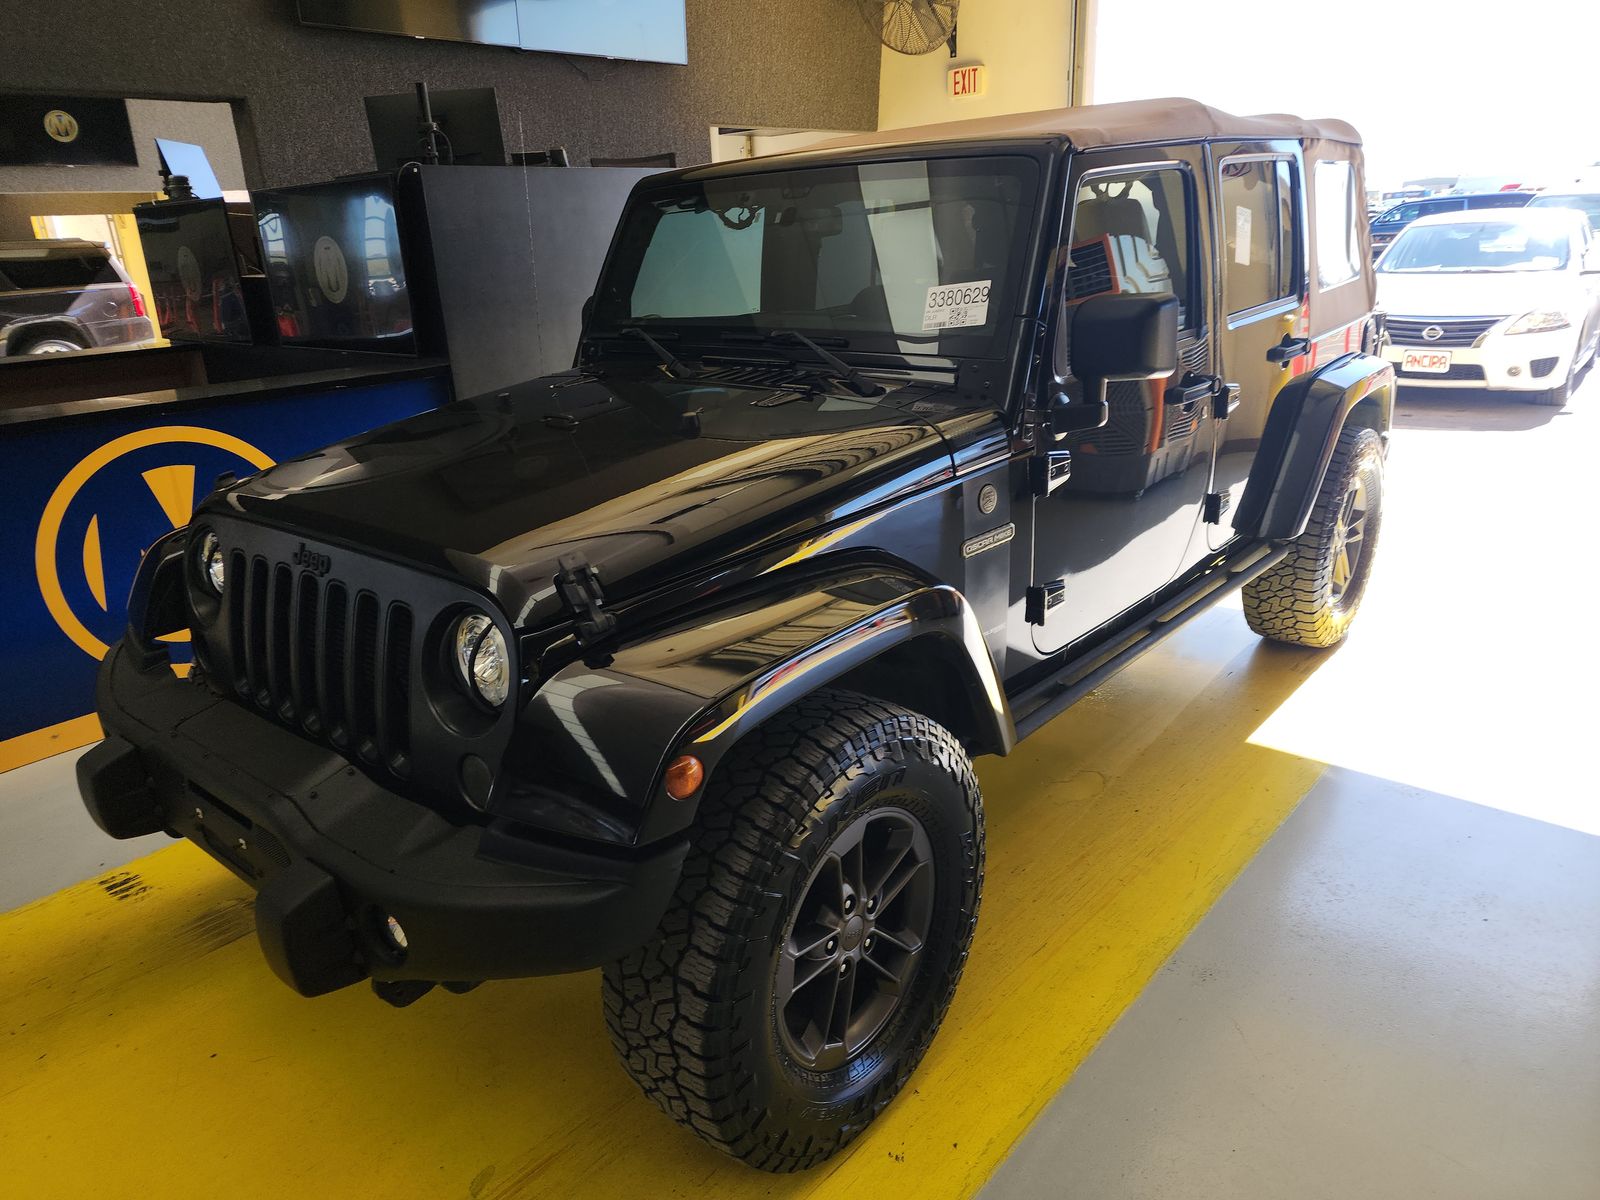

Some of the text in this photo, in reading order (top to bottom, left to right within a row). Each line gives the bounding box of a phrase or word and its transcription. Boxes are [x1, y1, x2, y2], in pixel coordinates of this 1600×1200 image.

[953, 68, 978, 95] EXIT
[928, 286, 990, 309] 3380629
[293, 542, 332, 577] Jeep
